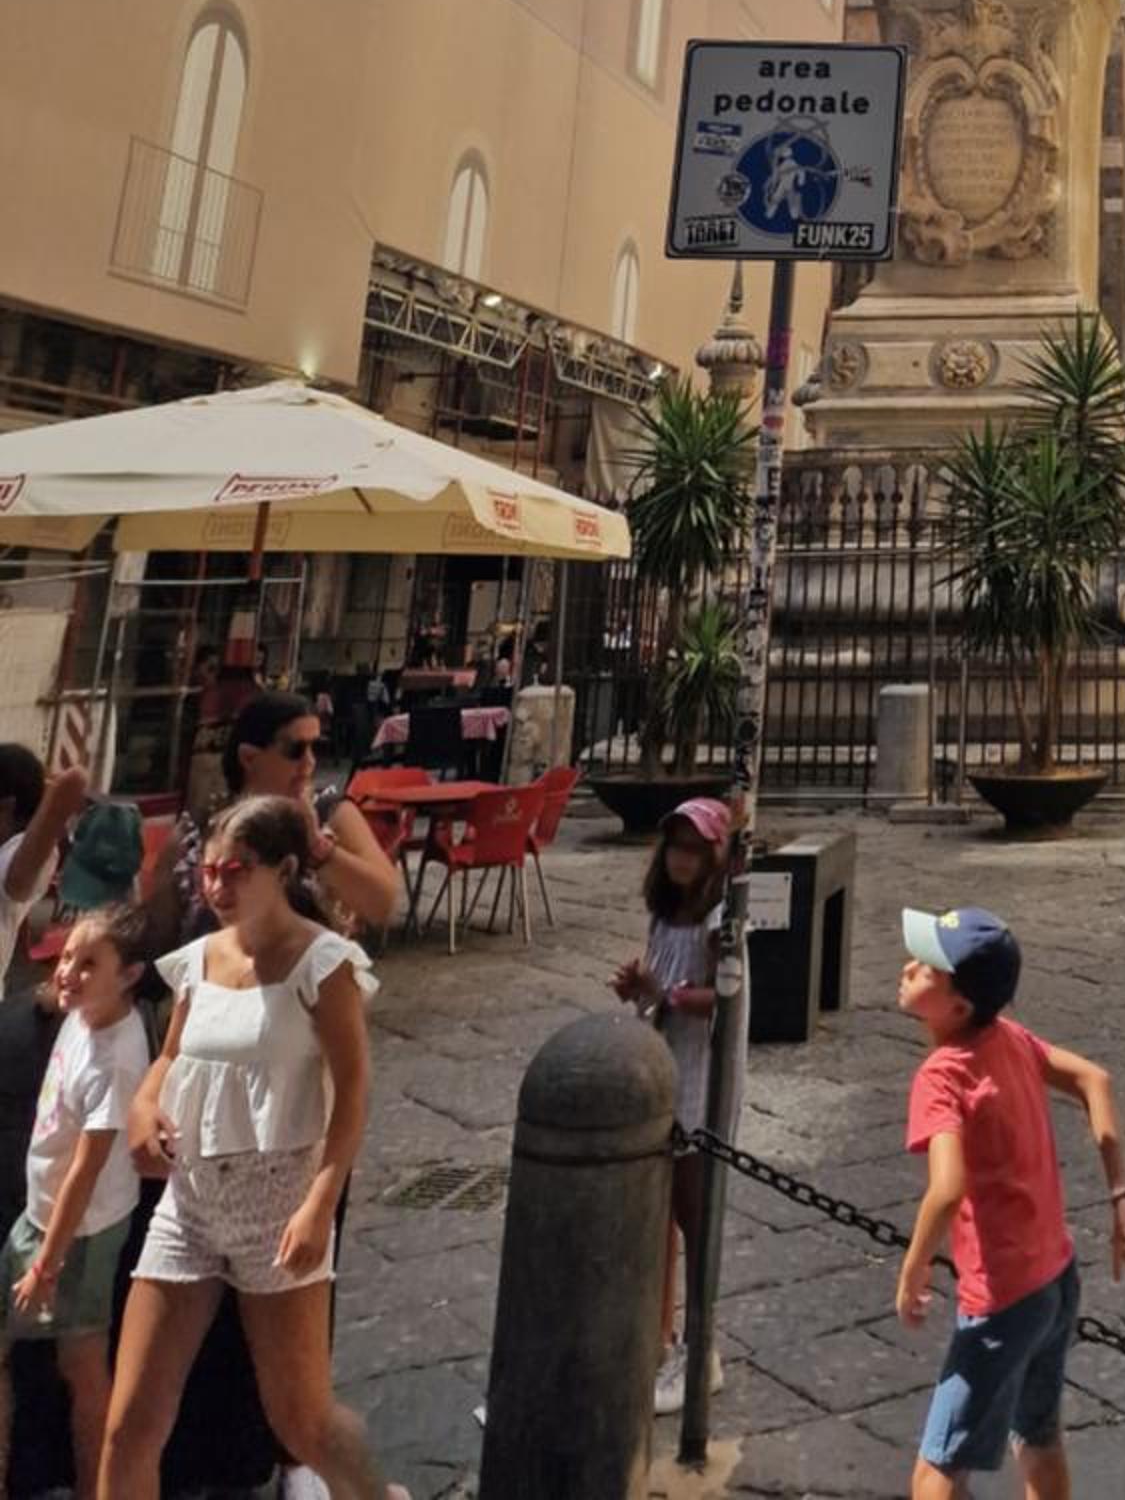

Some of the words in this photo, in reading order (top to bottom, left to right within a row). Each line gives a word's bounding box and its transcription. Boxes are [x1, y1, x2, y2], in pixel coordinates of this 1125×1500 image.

[758, 60, 831, 79] area
[713, 88, 870, 116] pedonale
[796, 224, 872, 247] FUNK25
